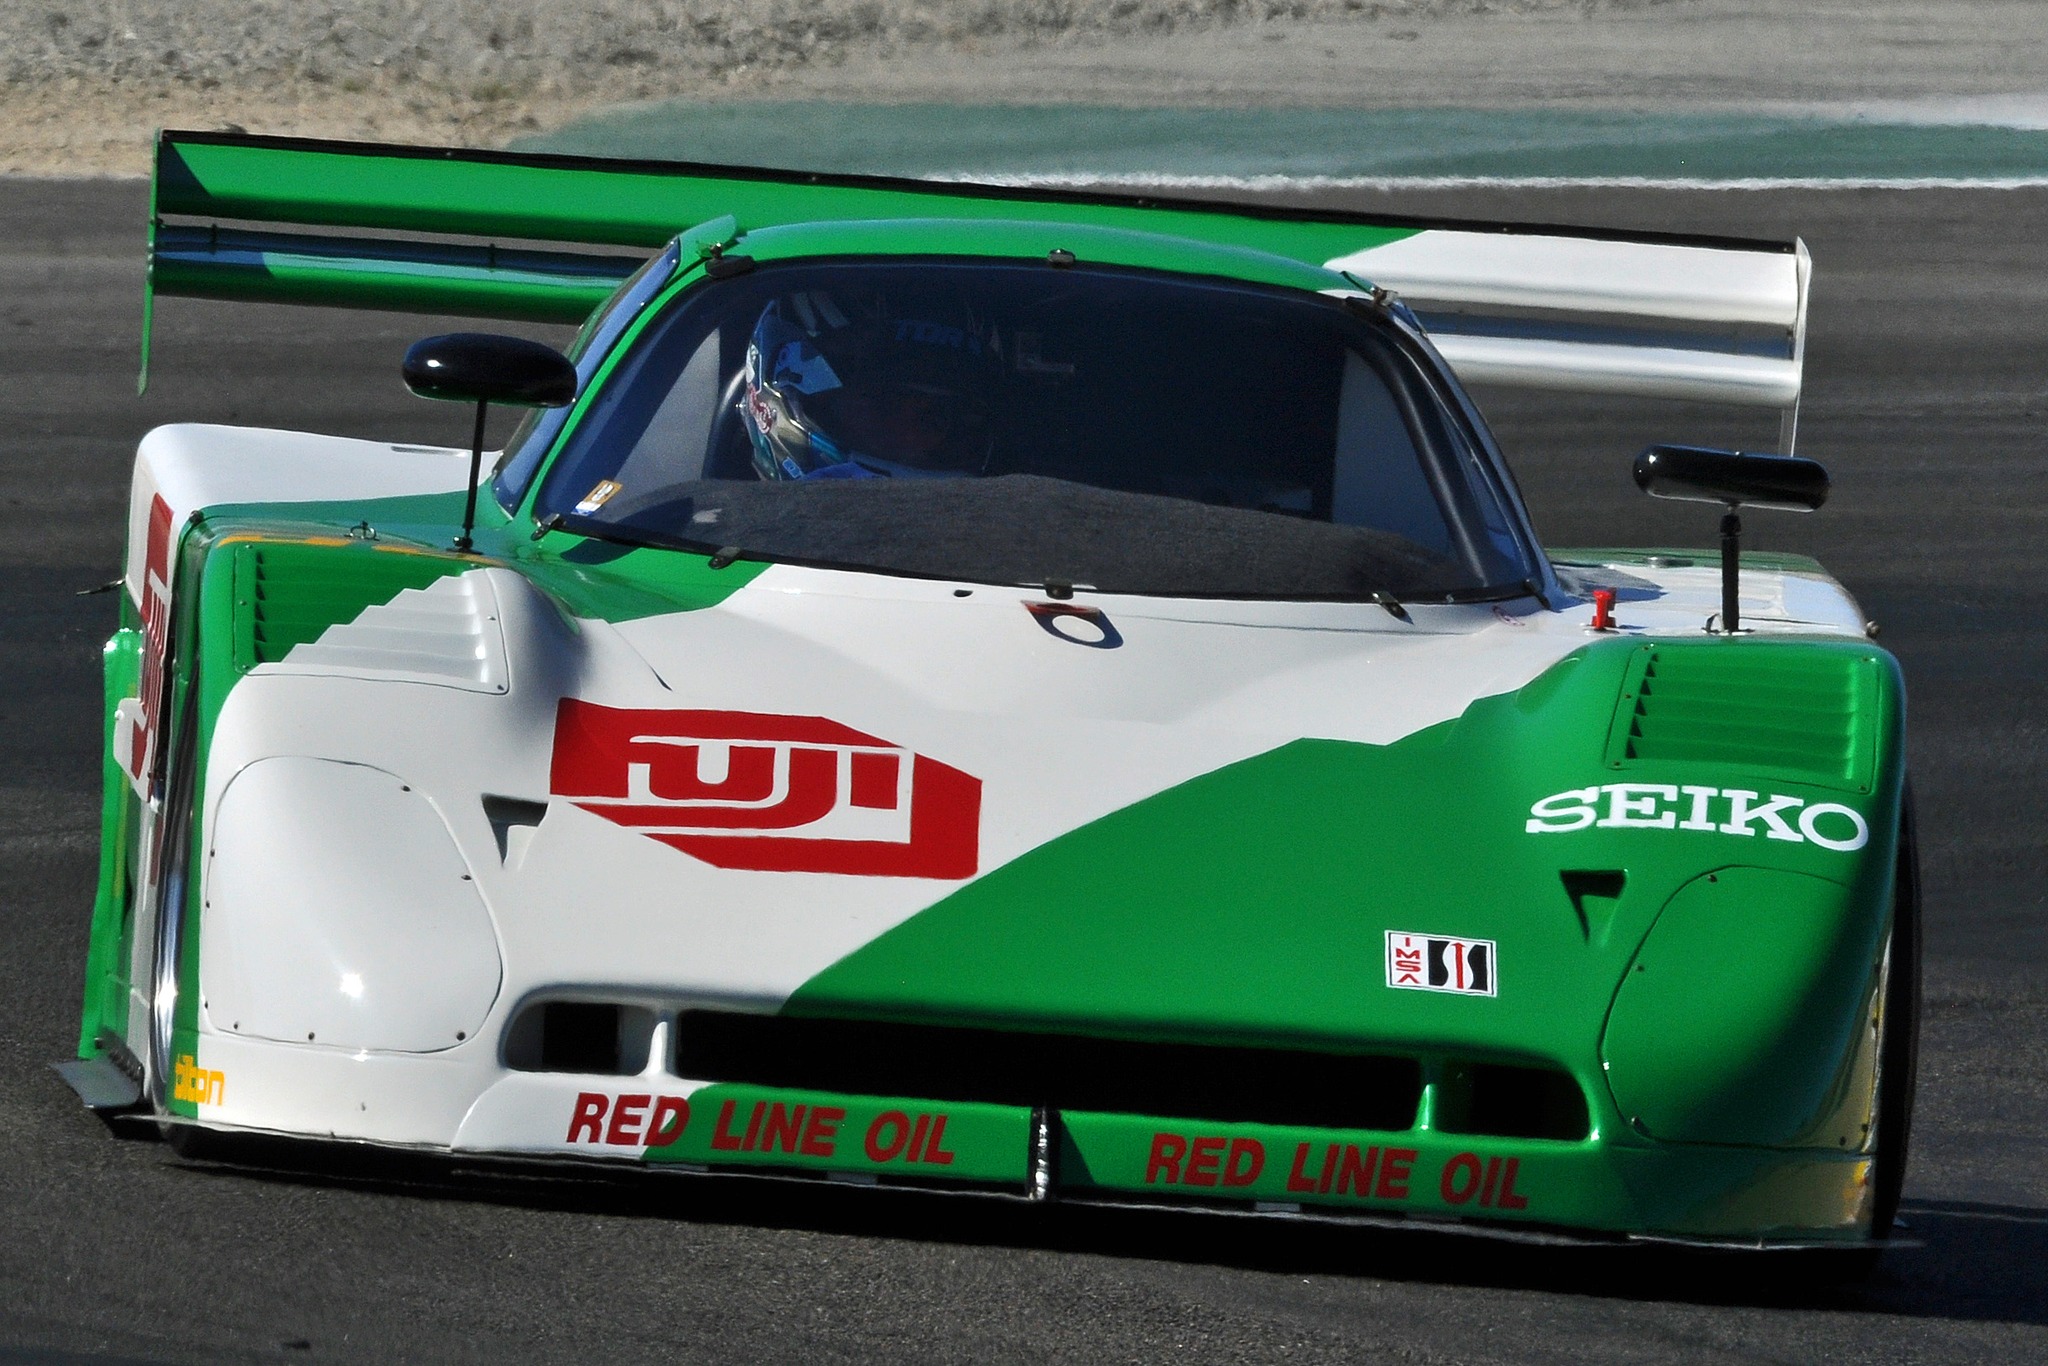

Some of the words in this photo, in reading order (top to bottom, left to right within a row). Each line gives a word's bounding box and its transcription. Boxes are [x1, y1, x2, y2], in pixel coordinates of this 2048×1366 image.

[1525, 783, 1868, 851] SEIKO
[1395, 936, 1422, 985] IMSA
[567, 1092, 690, 1147] RED
[710, 1099, 846, 1157] LINE
[864, 1110, 955, 1164] OIL
[1145, 1132, 1266, 1188] RED
[1286, 1142, 1418, 1199] LINE
[1440, 1152, 1528, 1210] OIL
